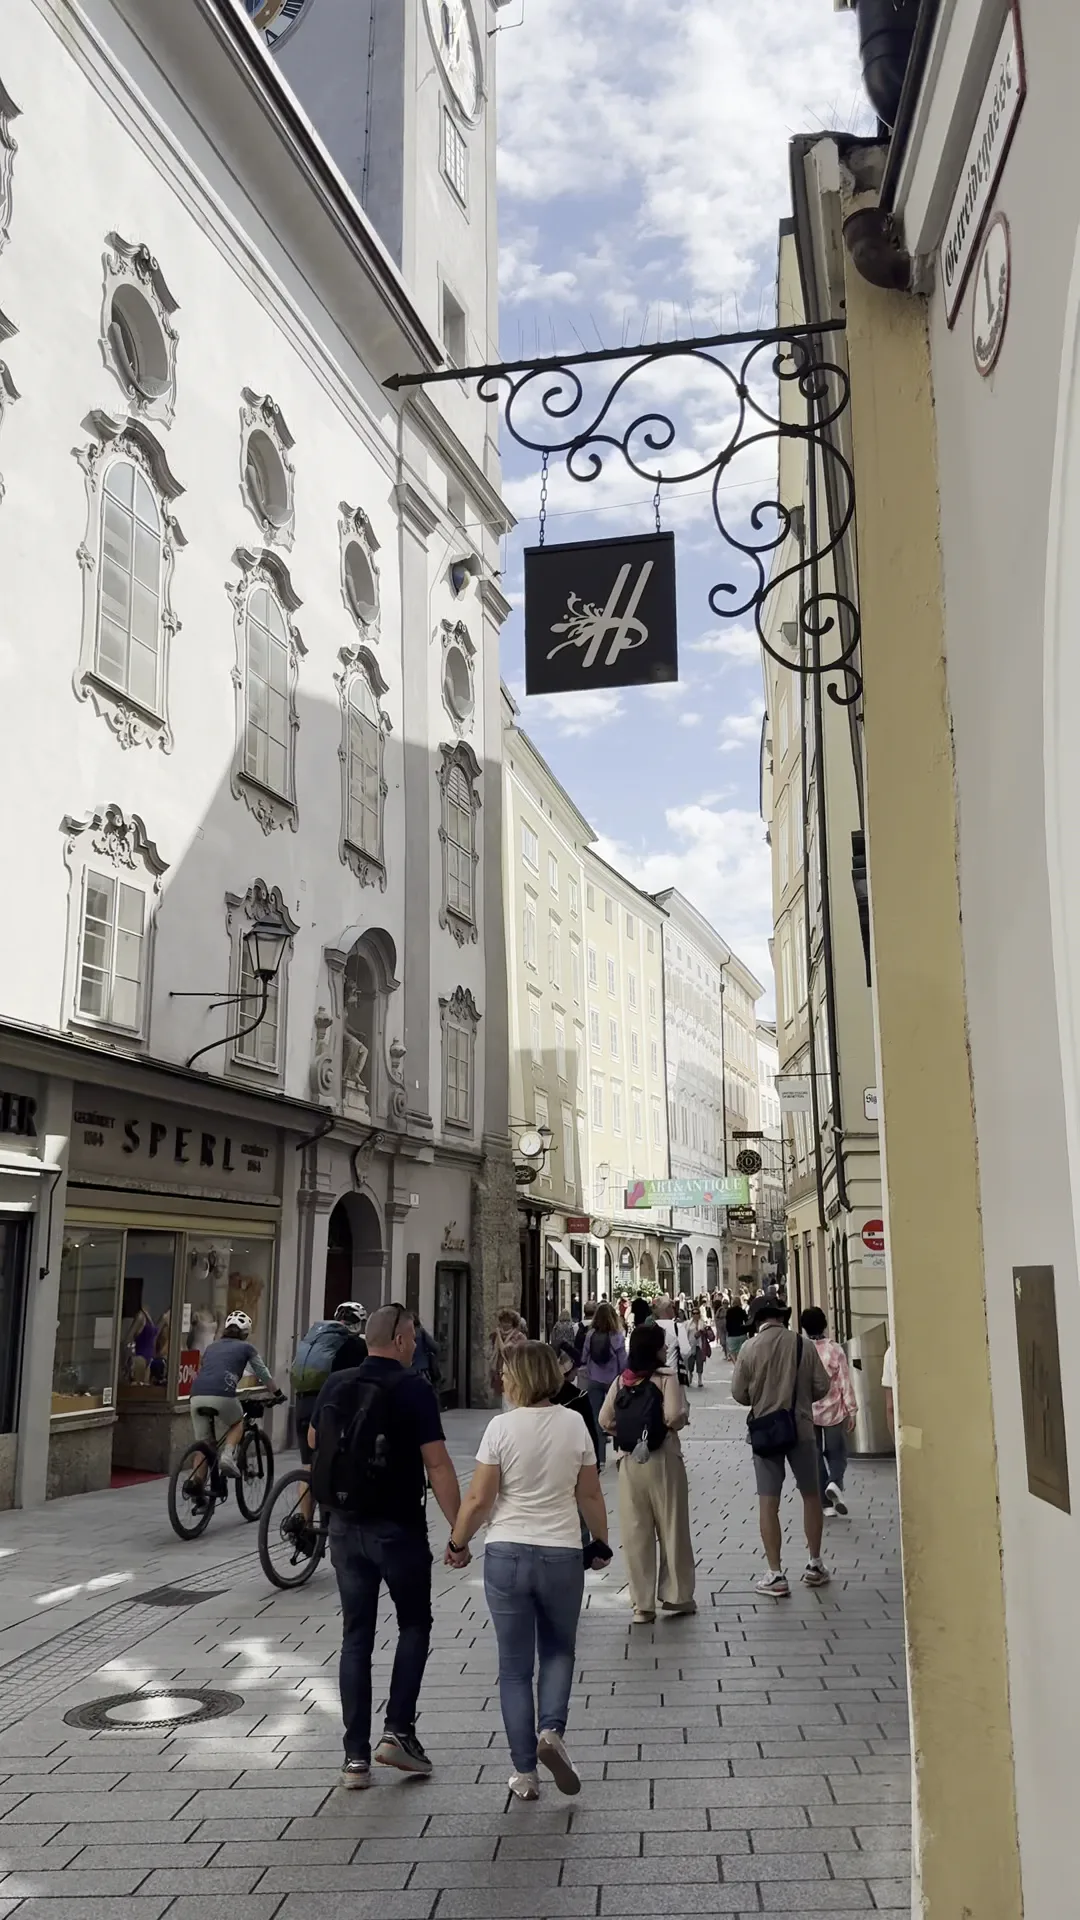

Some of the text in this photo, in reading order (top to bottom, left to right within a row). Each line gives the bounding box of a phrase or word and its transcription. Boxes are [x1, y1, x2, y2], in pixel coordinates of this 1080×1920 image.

[944, 52, 1013, 288] Getreidegasse
[0, 1090, 38, 1137] ER
[122, 1119, 235, 1172] SPERL
